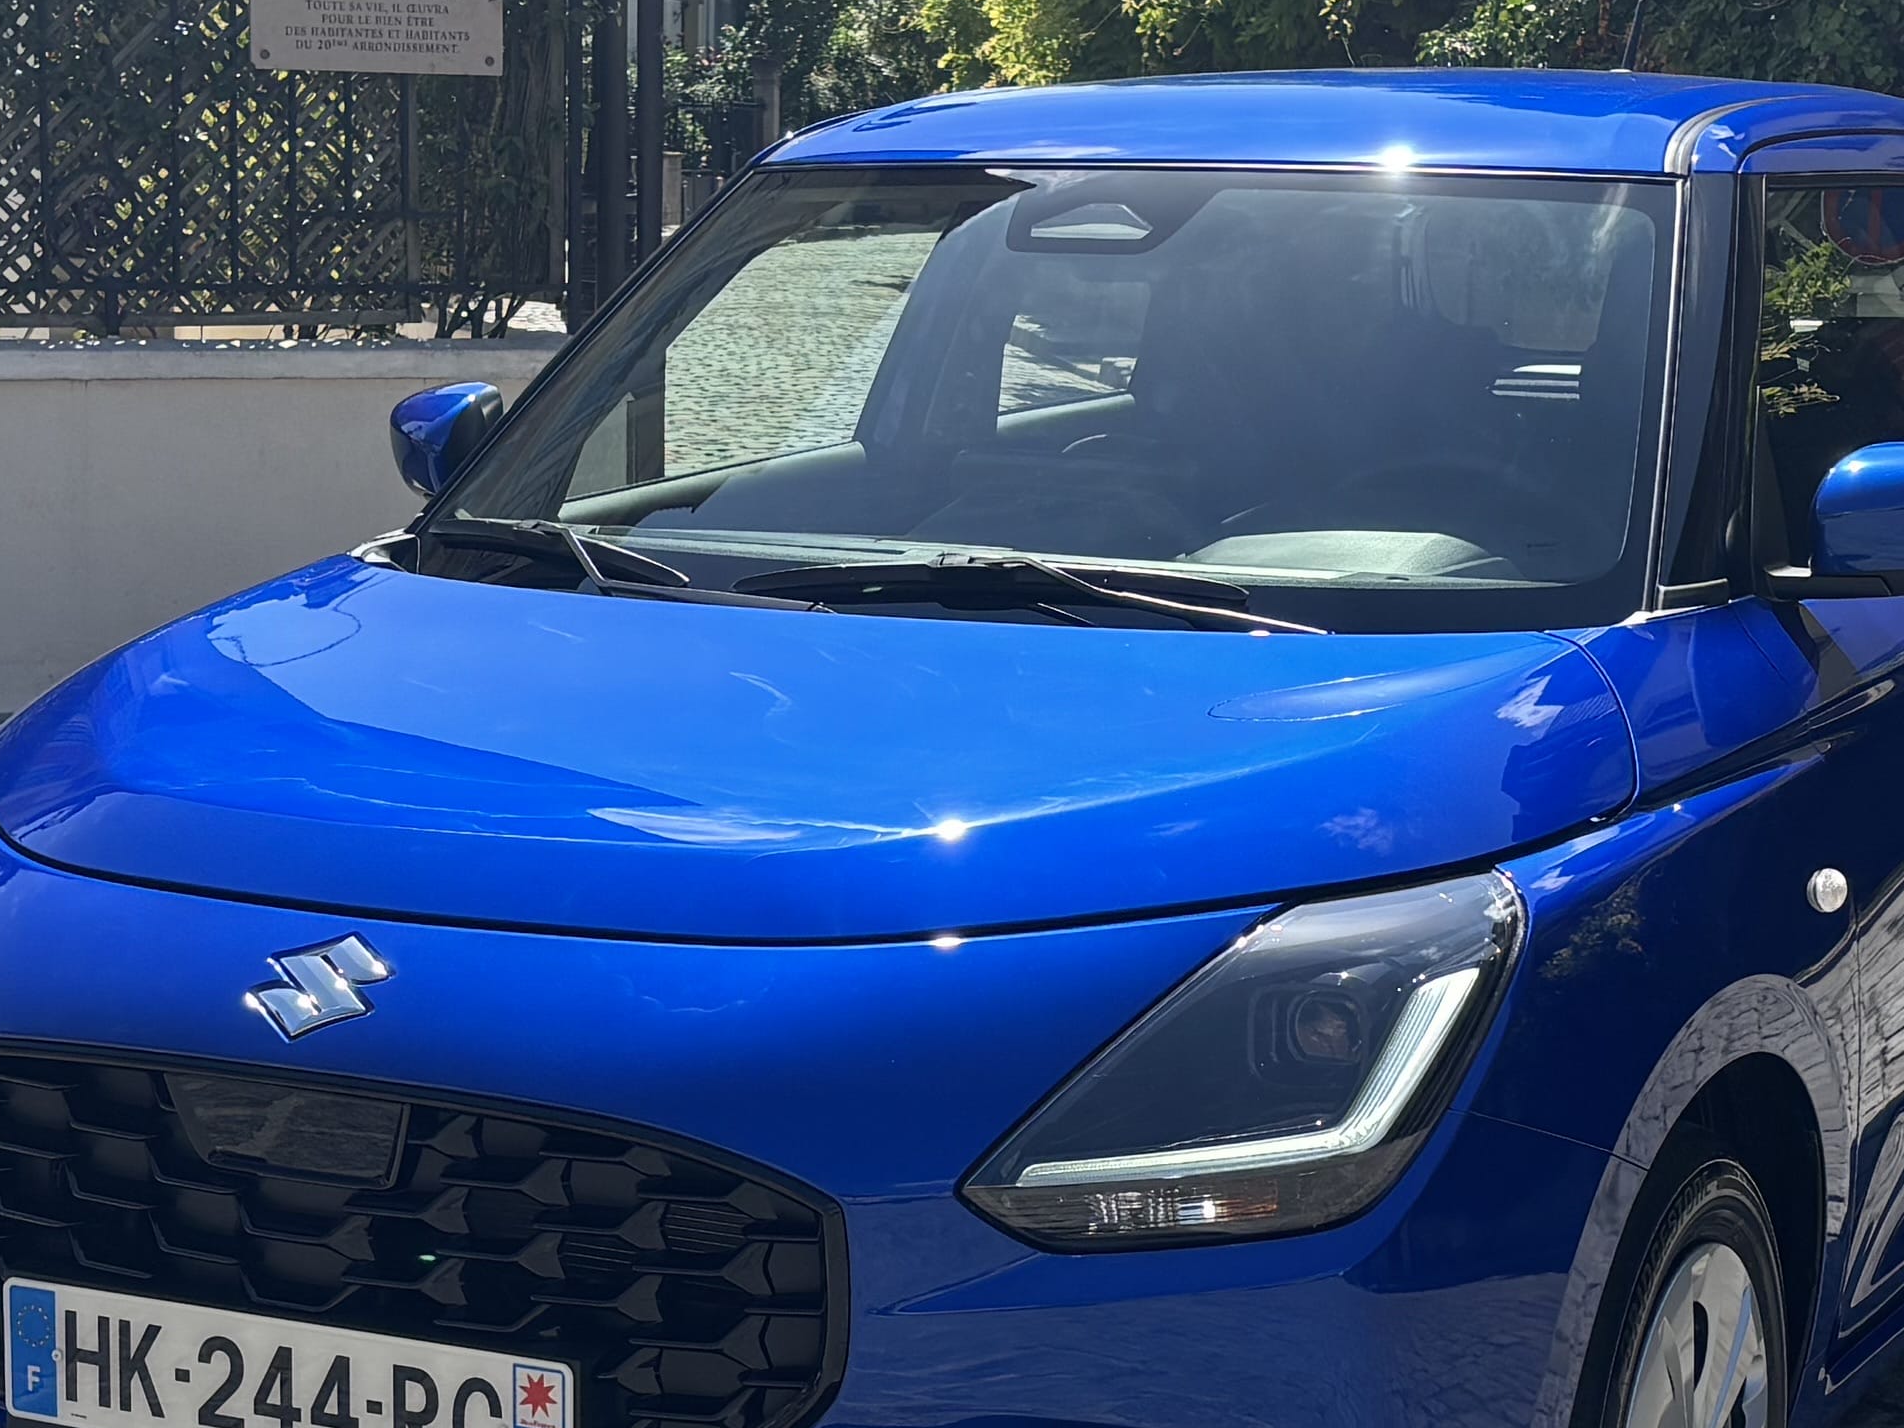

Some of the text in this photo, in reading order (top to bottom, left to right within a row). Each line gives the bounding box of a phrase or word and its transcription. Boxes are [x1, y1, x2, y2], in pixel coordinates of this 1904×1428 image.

[304, 0, 346, 11] TOUTE
[348, 2, 364, 13] SA
[391, 3, 403, 15] IL
[321, 14, 355, 25] POUR
[357, 16, 373, 27] LE
[284, 26, 472, 43] DES HABITANTES ET HABITANTS
[294, 39, 313, 50] DU
[27, 1365, 41, 1392] F
